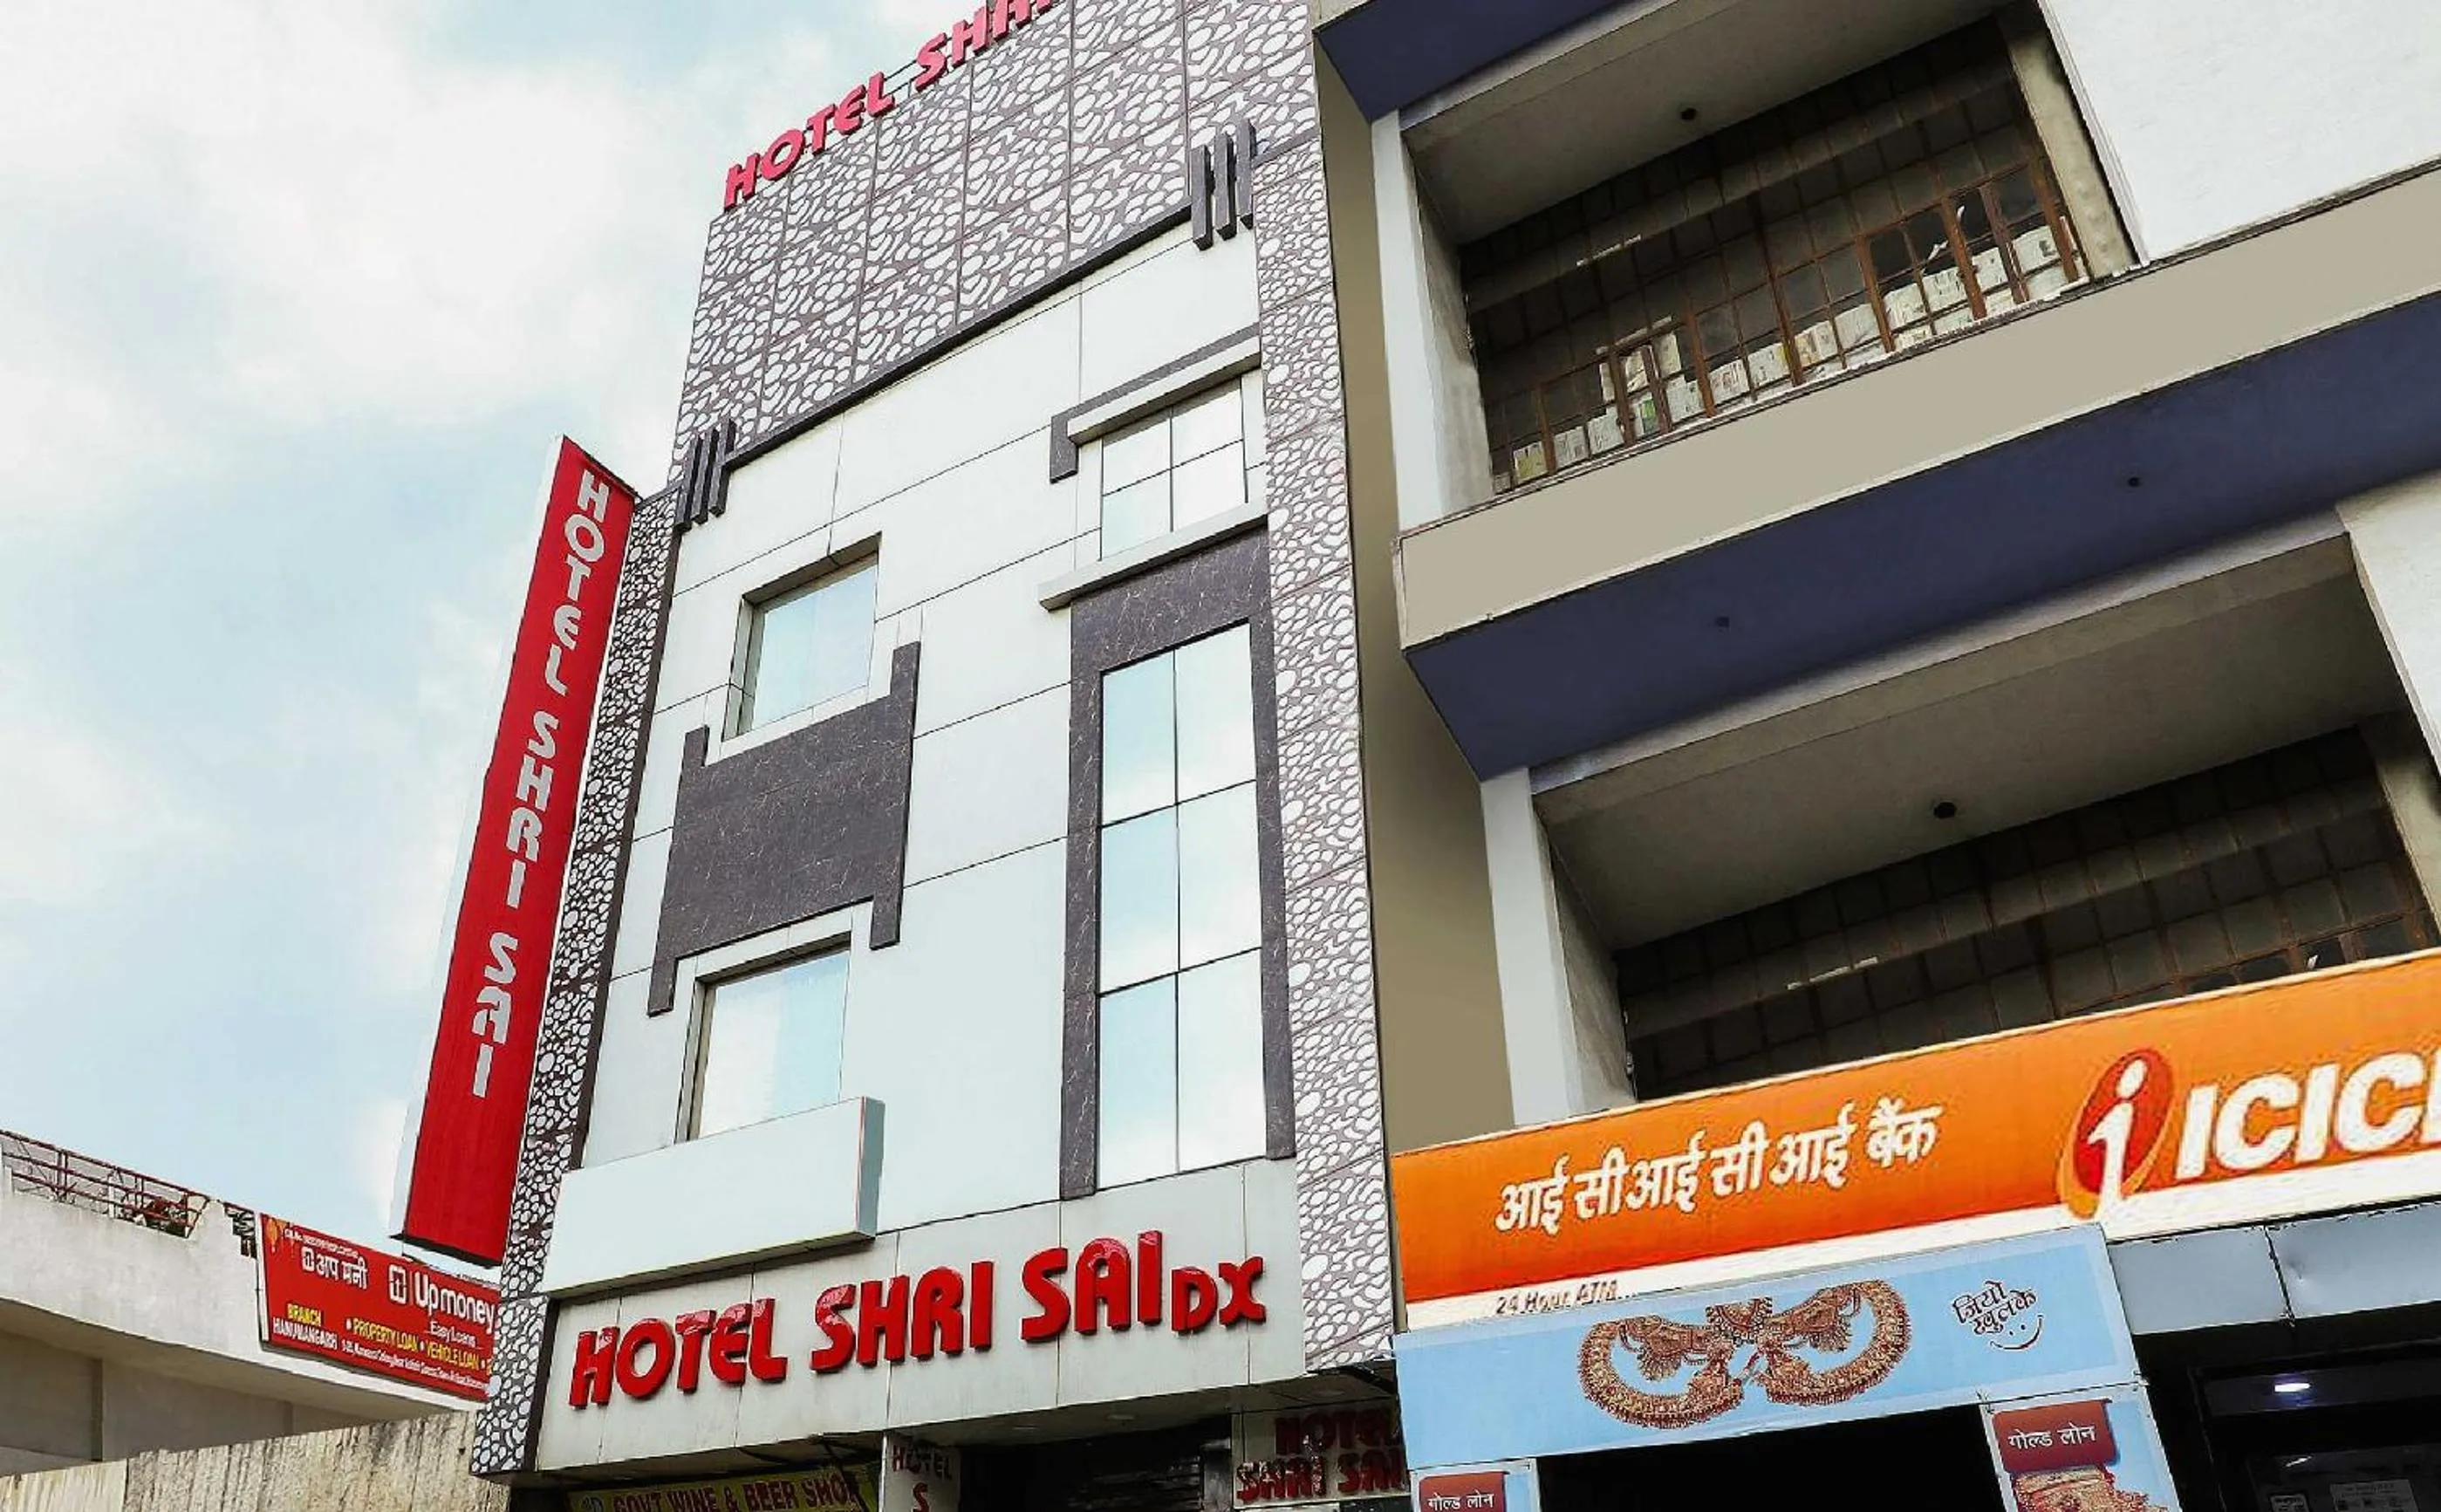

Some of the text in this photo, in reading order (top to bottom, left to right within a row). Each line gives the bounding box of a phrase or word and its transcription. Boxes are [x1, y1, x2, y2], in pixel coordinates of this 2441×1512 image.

[723, 0, 1053, 211] HOTEL SHR
[471, 469, 610, 1098] HOTEL SHRI SAI
[287, 1303, 322, 1327] BRANCH
[569, 1297, 789, 1410] HOTEL
[810, 1261, 995, 1374] SHRI
[352, 1317, 397, 1344] PROPERTY
[397, 1331, 419, 1351] LOAN
[426, 1338, 458, 1365] VEHICLE
[459, 1348, 480, 1371] LOAN
[2007, 1421, 2096, 1450] गोल्ड लोन
[665, 1487, 718, 1512] WINE
[742, 1481, 799, 1511] BEER
[1427, 1488, 1494, 1511] गोल्ड लोन
